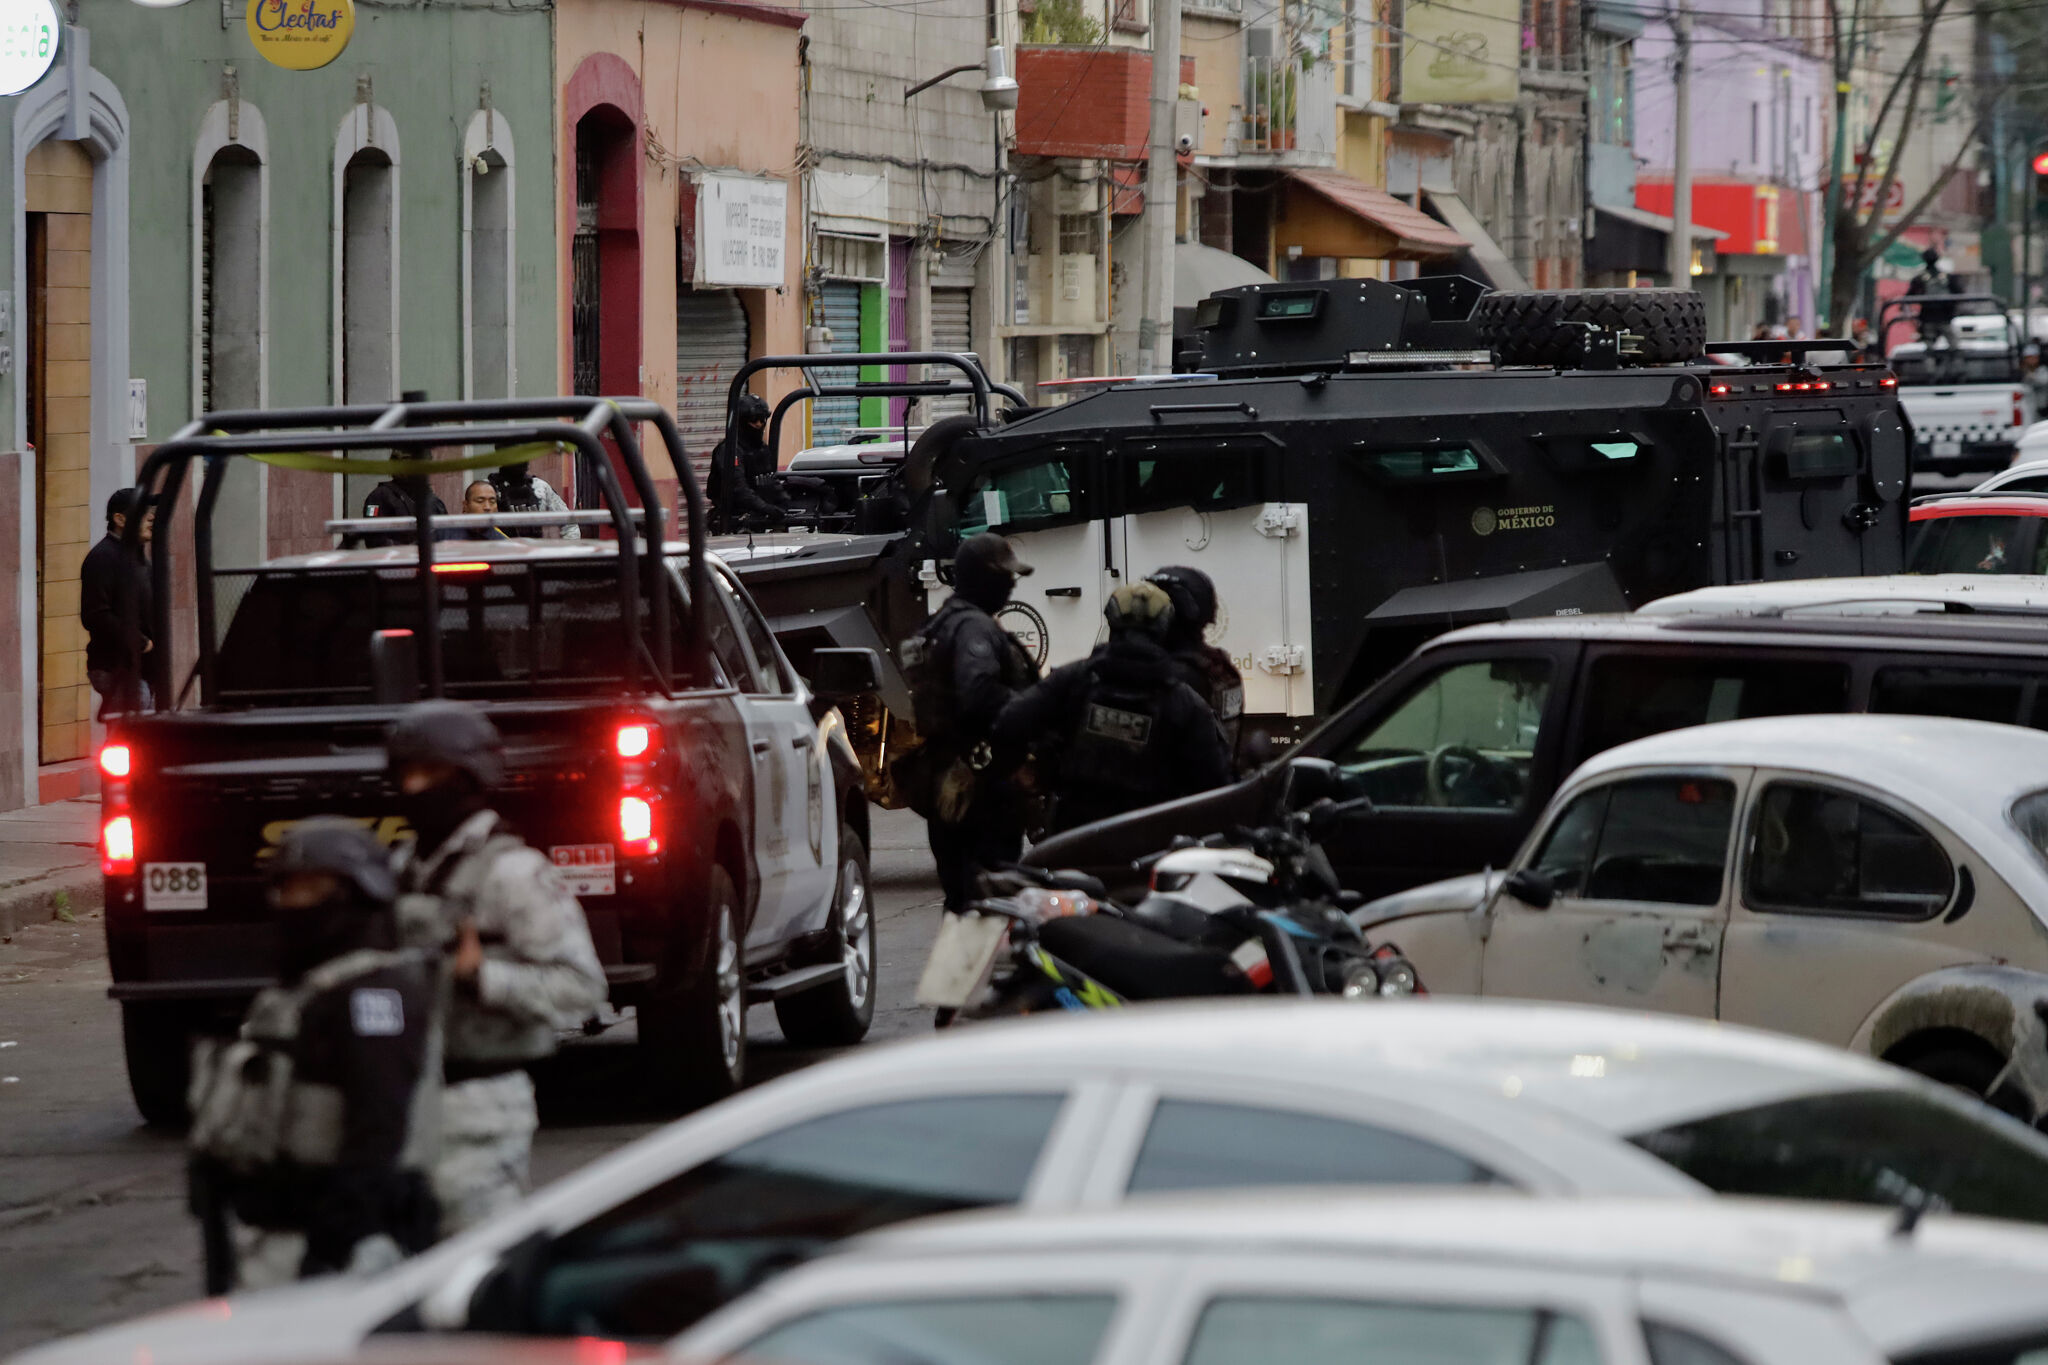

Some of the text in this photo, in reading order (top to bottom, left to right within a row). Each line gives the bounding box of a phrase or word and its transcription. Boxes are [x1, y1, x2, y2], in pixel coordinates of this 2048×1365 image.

[1497, 505, 1554, 516] GOBIERNO DE
[1498, 514, 1555, 530] MÉXICO
[1555, 607, 1584, 616] DIESEL
[150, 867, 200, 892] 088
